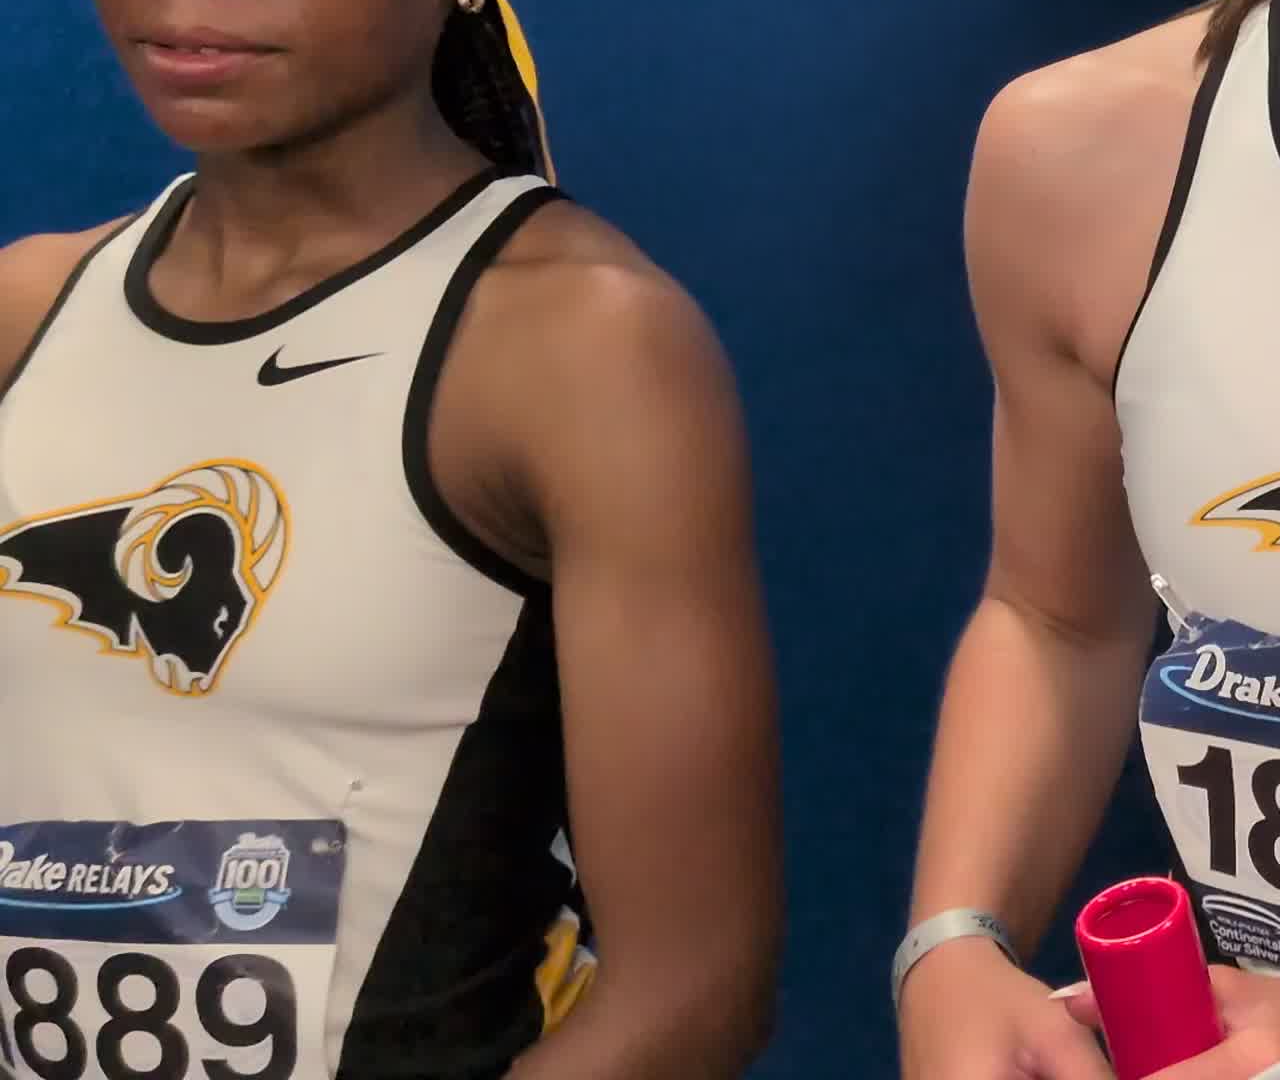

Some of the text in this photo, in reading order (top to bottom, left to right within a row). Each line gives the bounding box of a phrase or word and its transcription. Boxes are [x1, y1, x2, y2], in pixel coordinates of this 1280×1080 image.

[66, 863, 175, 896] RELAYS
[224, 859, 281, 889] 100
[1216, 935, 1280, 962] Tour Silver
[0, 947, 298, 1080] 889
